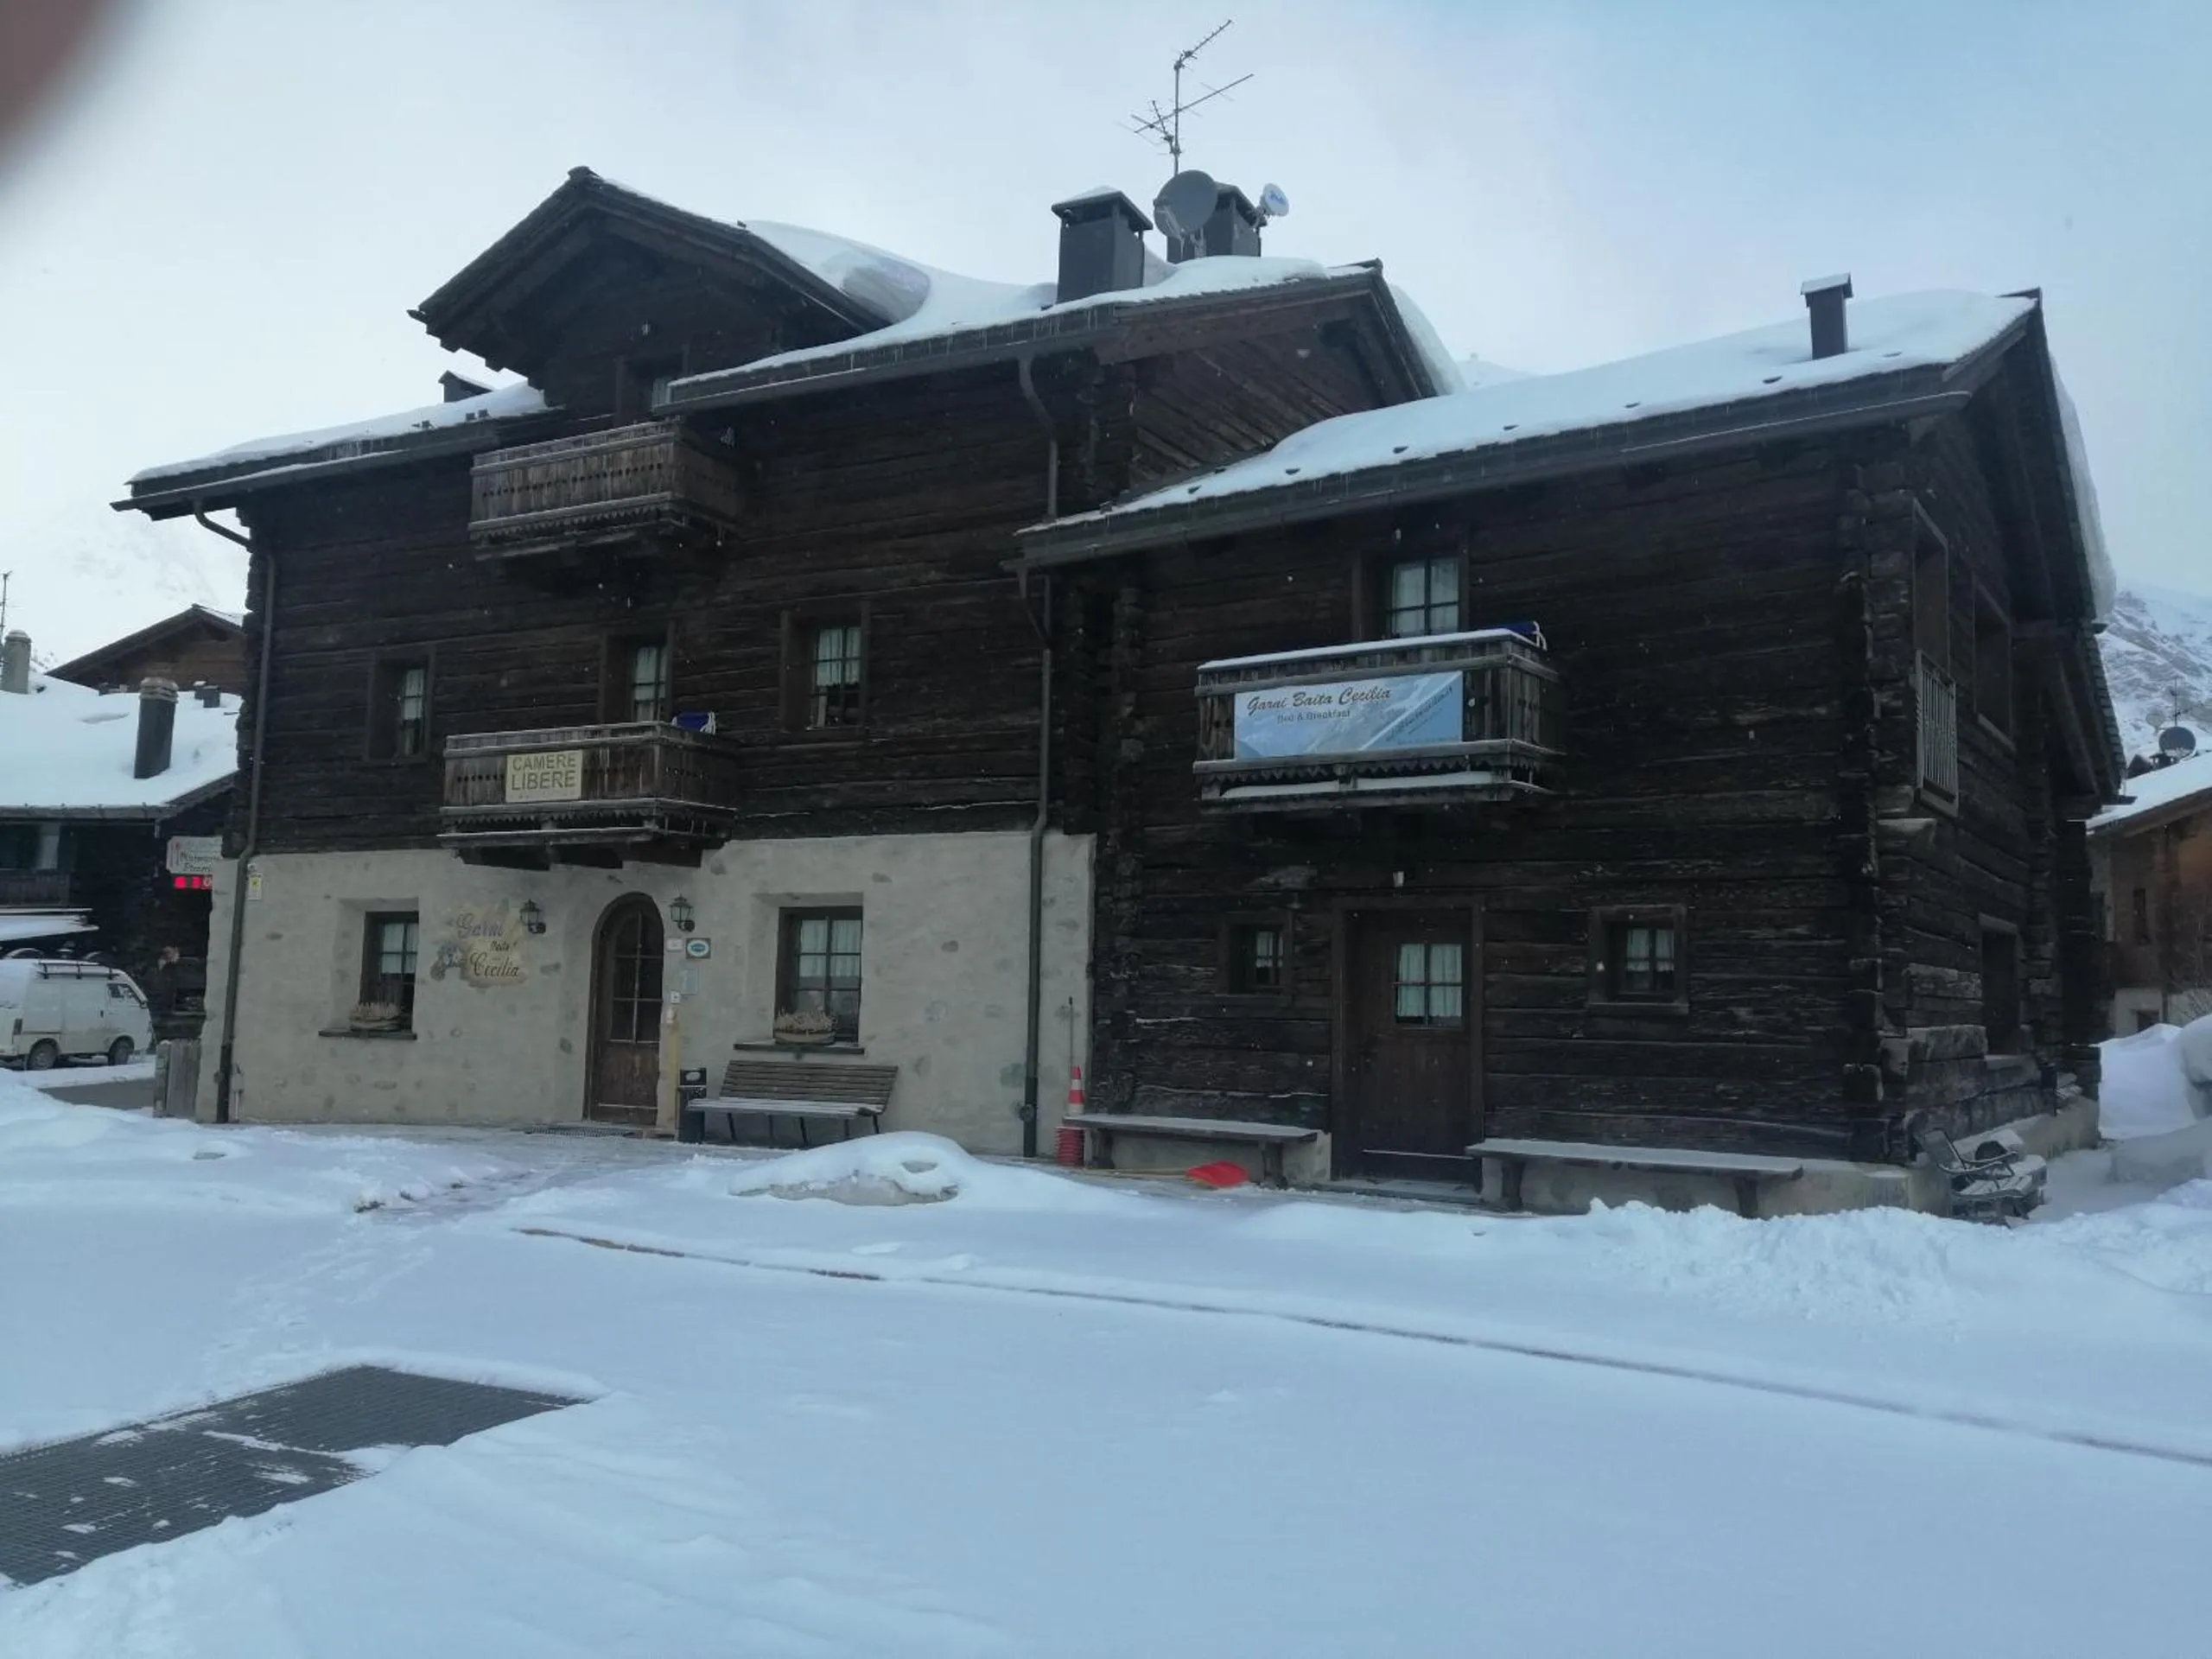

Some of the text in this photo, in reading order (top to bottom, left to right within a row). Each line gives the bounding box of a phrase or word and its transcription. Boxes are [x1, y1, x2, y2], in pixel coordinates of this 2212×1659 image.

[1247, 685, 1391, 715] Garni Baita Cecilia
[1306, 709, 1351, 721] Breakfast
[512, 753, 576, 772] CAMERE
[512, 770, 576, 791] LIBERE
